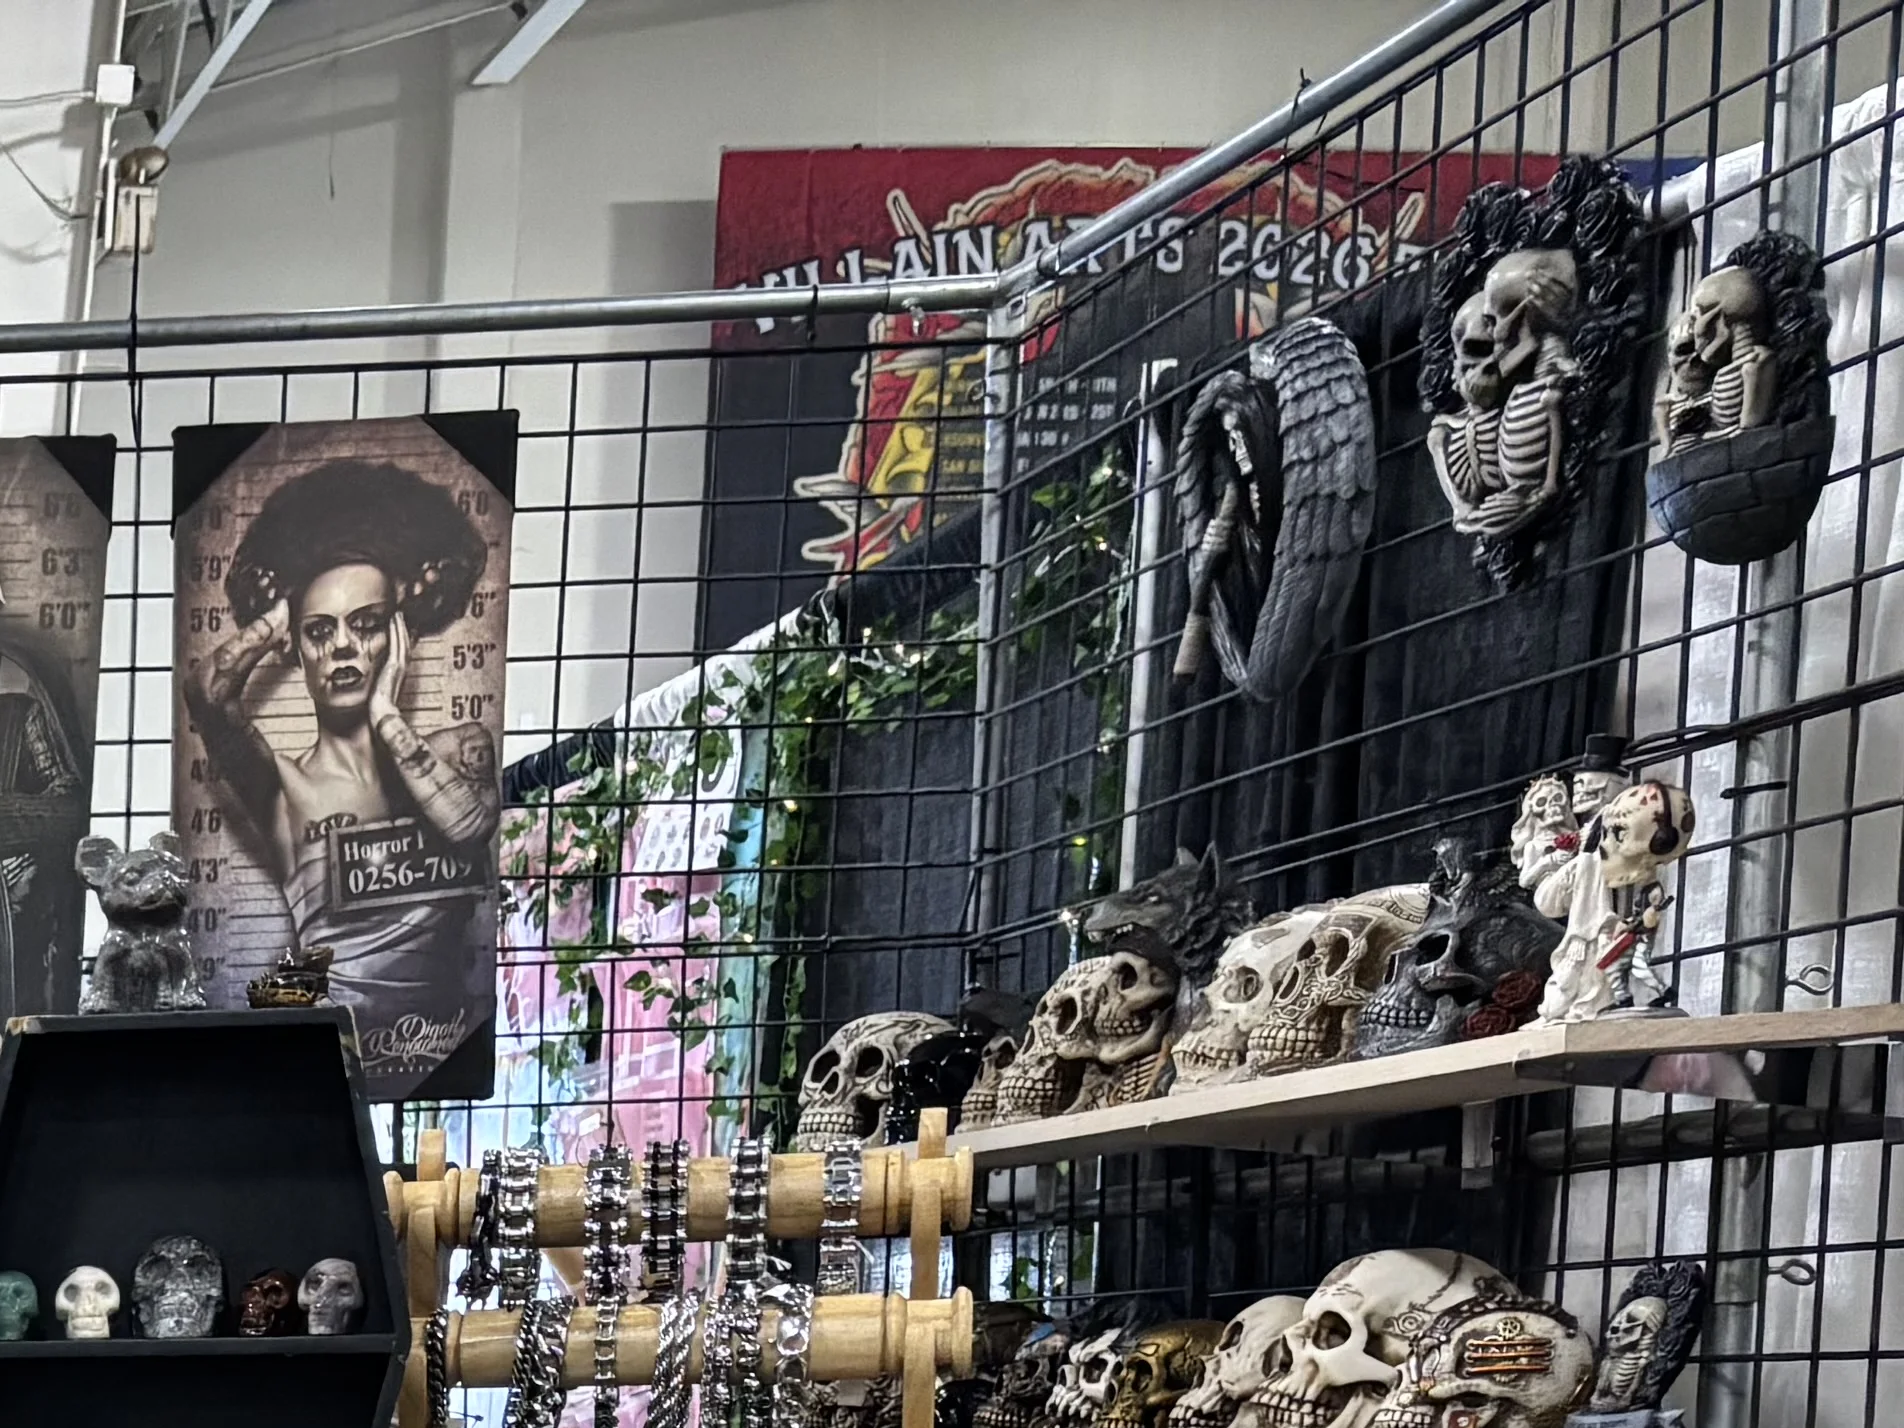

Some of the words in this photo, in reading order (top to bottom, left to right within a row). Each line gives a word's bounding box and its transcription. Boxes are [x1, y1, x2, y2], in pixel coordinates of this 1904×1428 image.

[1218, 219, 1378, 291] 2026
[453, 643, 497, 671] 5'3"
[451, 693, 494, 722] 5'0"
[343, 836, 412, 862] Horror
